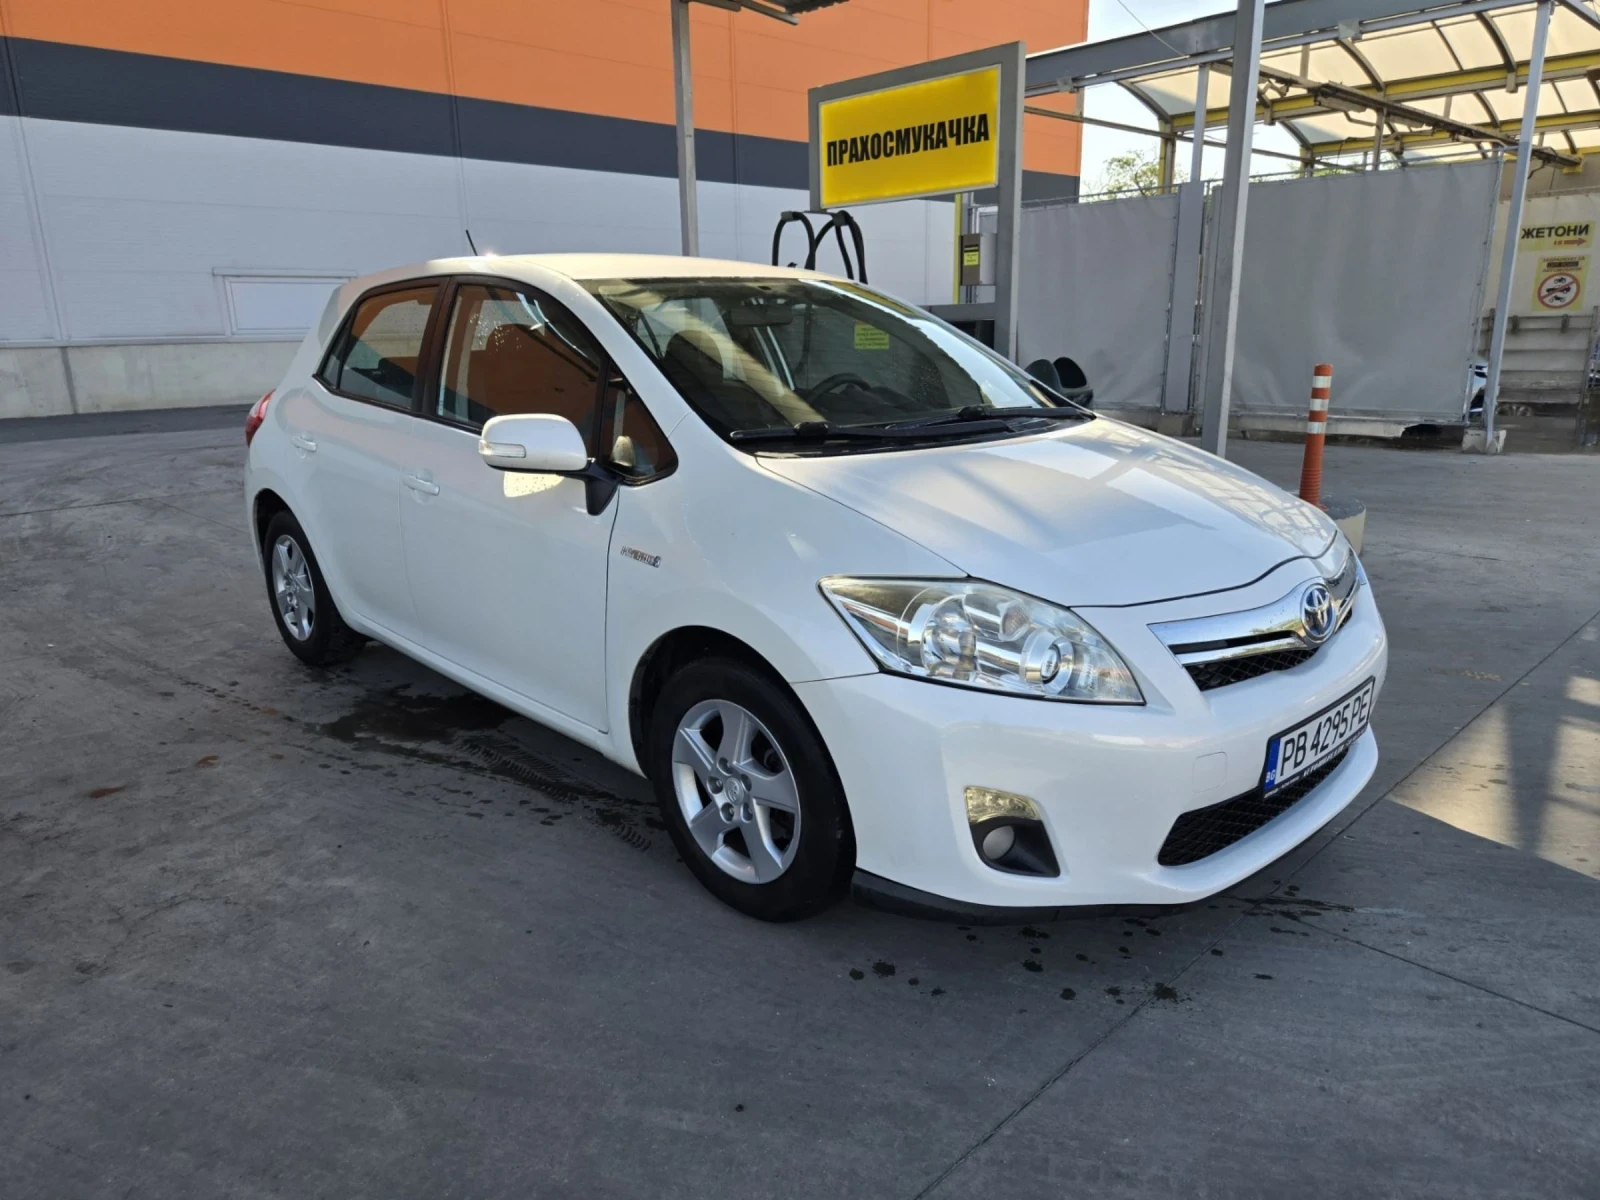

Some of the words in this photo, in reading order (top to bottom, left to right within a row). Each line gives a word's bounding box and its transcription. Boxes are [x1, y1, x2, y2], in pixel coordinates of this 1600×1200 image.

[827, 113, 990, 167] ПРАХОСМУКАЧКА
[1521, 224, 1590, 239] ЖЕТОНИ
[1280, 731, 1308, 777] PB
[1310, 703, 1350, 756] 4295
[1350, 688, 1370, 731] PE
[1265, 769, 1276, 783] BG
